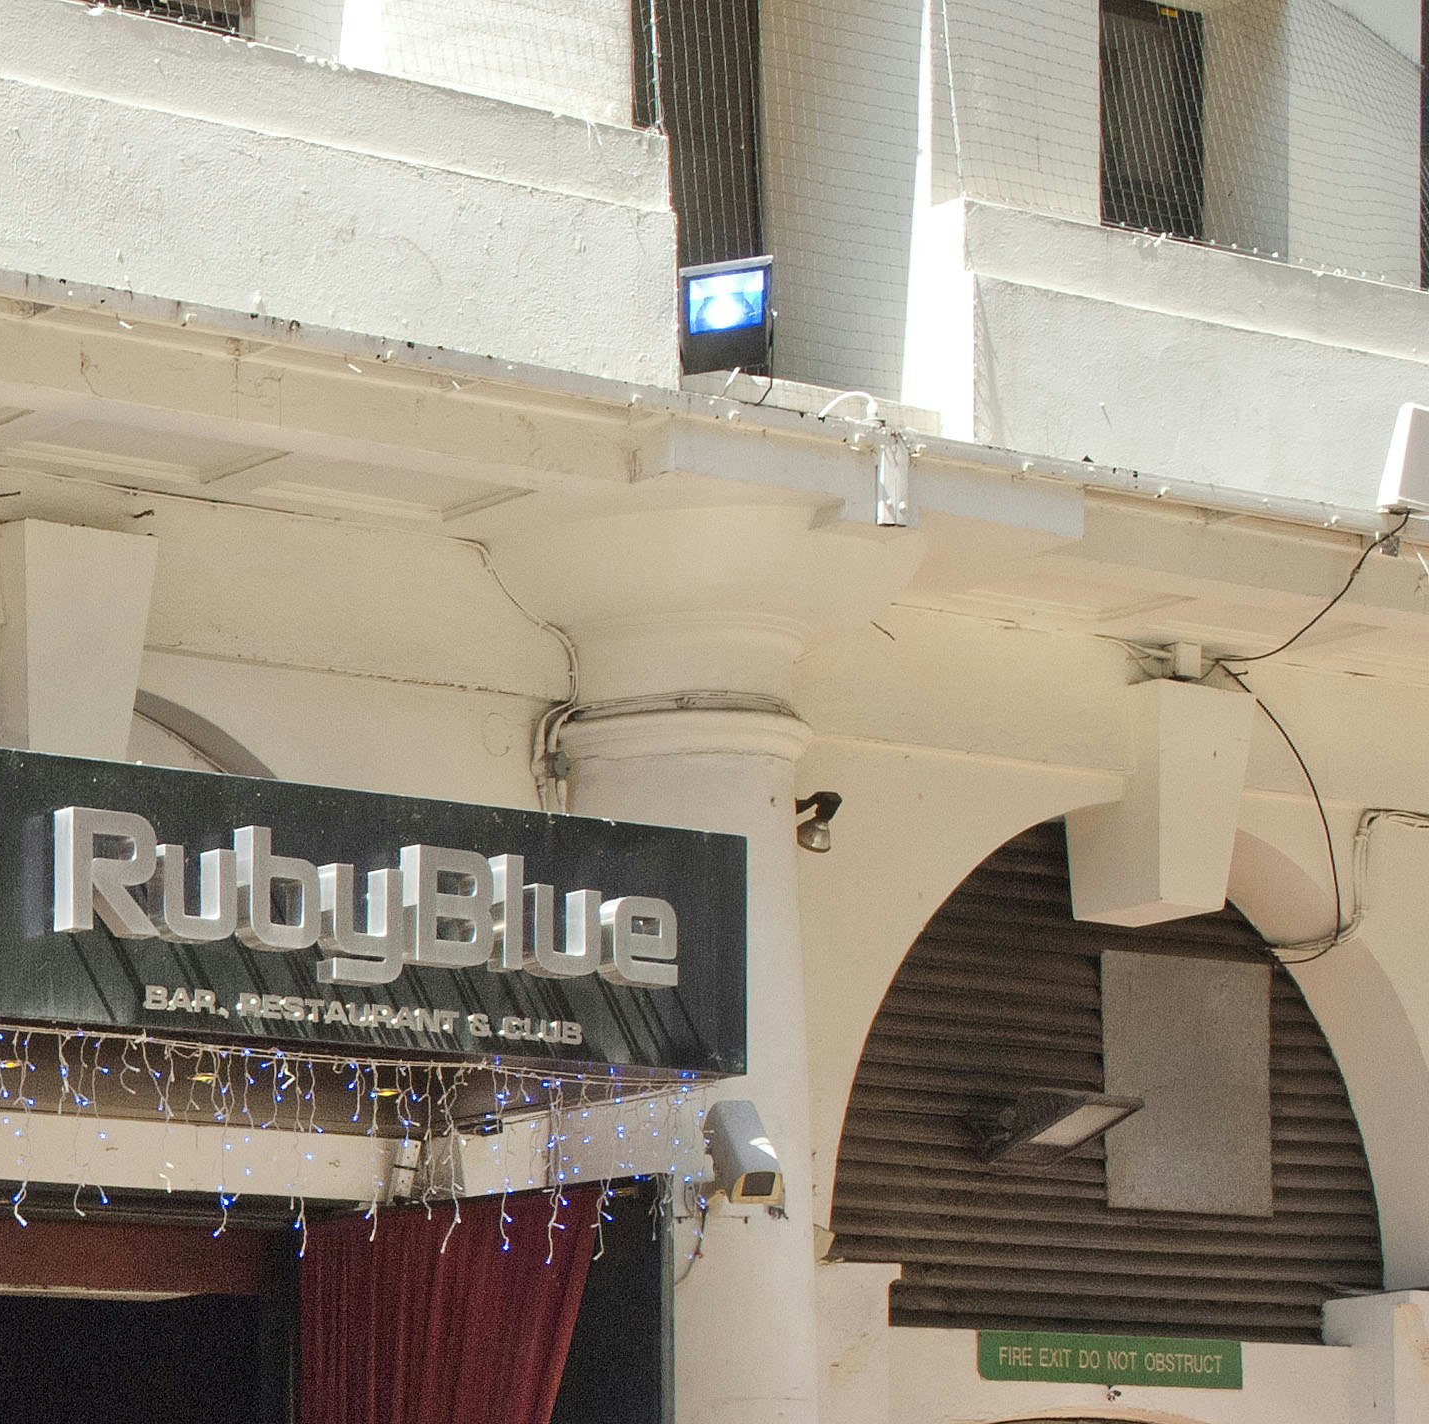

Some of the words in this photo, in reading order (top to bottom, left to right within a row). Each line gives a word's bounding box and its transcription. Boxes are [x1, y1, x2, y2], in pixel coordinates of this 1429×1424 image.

[53, 805, 679, 988] RubyBlue
[144, 985, 230, 1019] BAR,
[238, 993, 460, 1034] RESTAURANT
[468, 1014, 492, 1037] &
[499, 1016, 583, 1045] CLUB
[998, 1346, 1032, 1366] FIRE
[1039, 1348, 1072, 1368] EXIT
[1078, 1350, 1101, 1369] DO
[1107, 1351, 1137, 1371] NOT
[1144, 1352, 1222, 1374] OBSTRUCT
